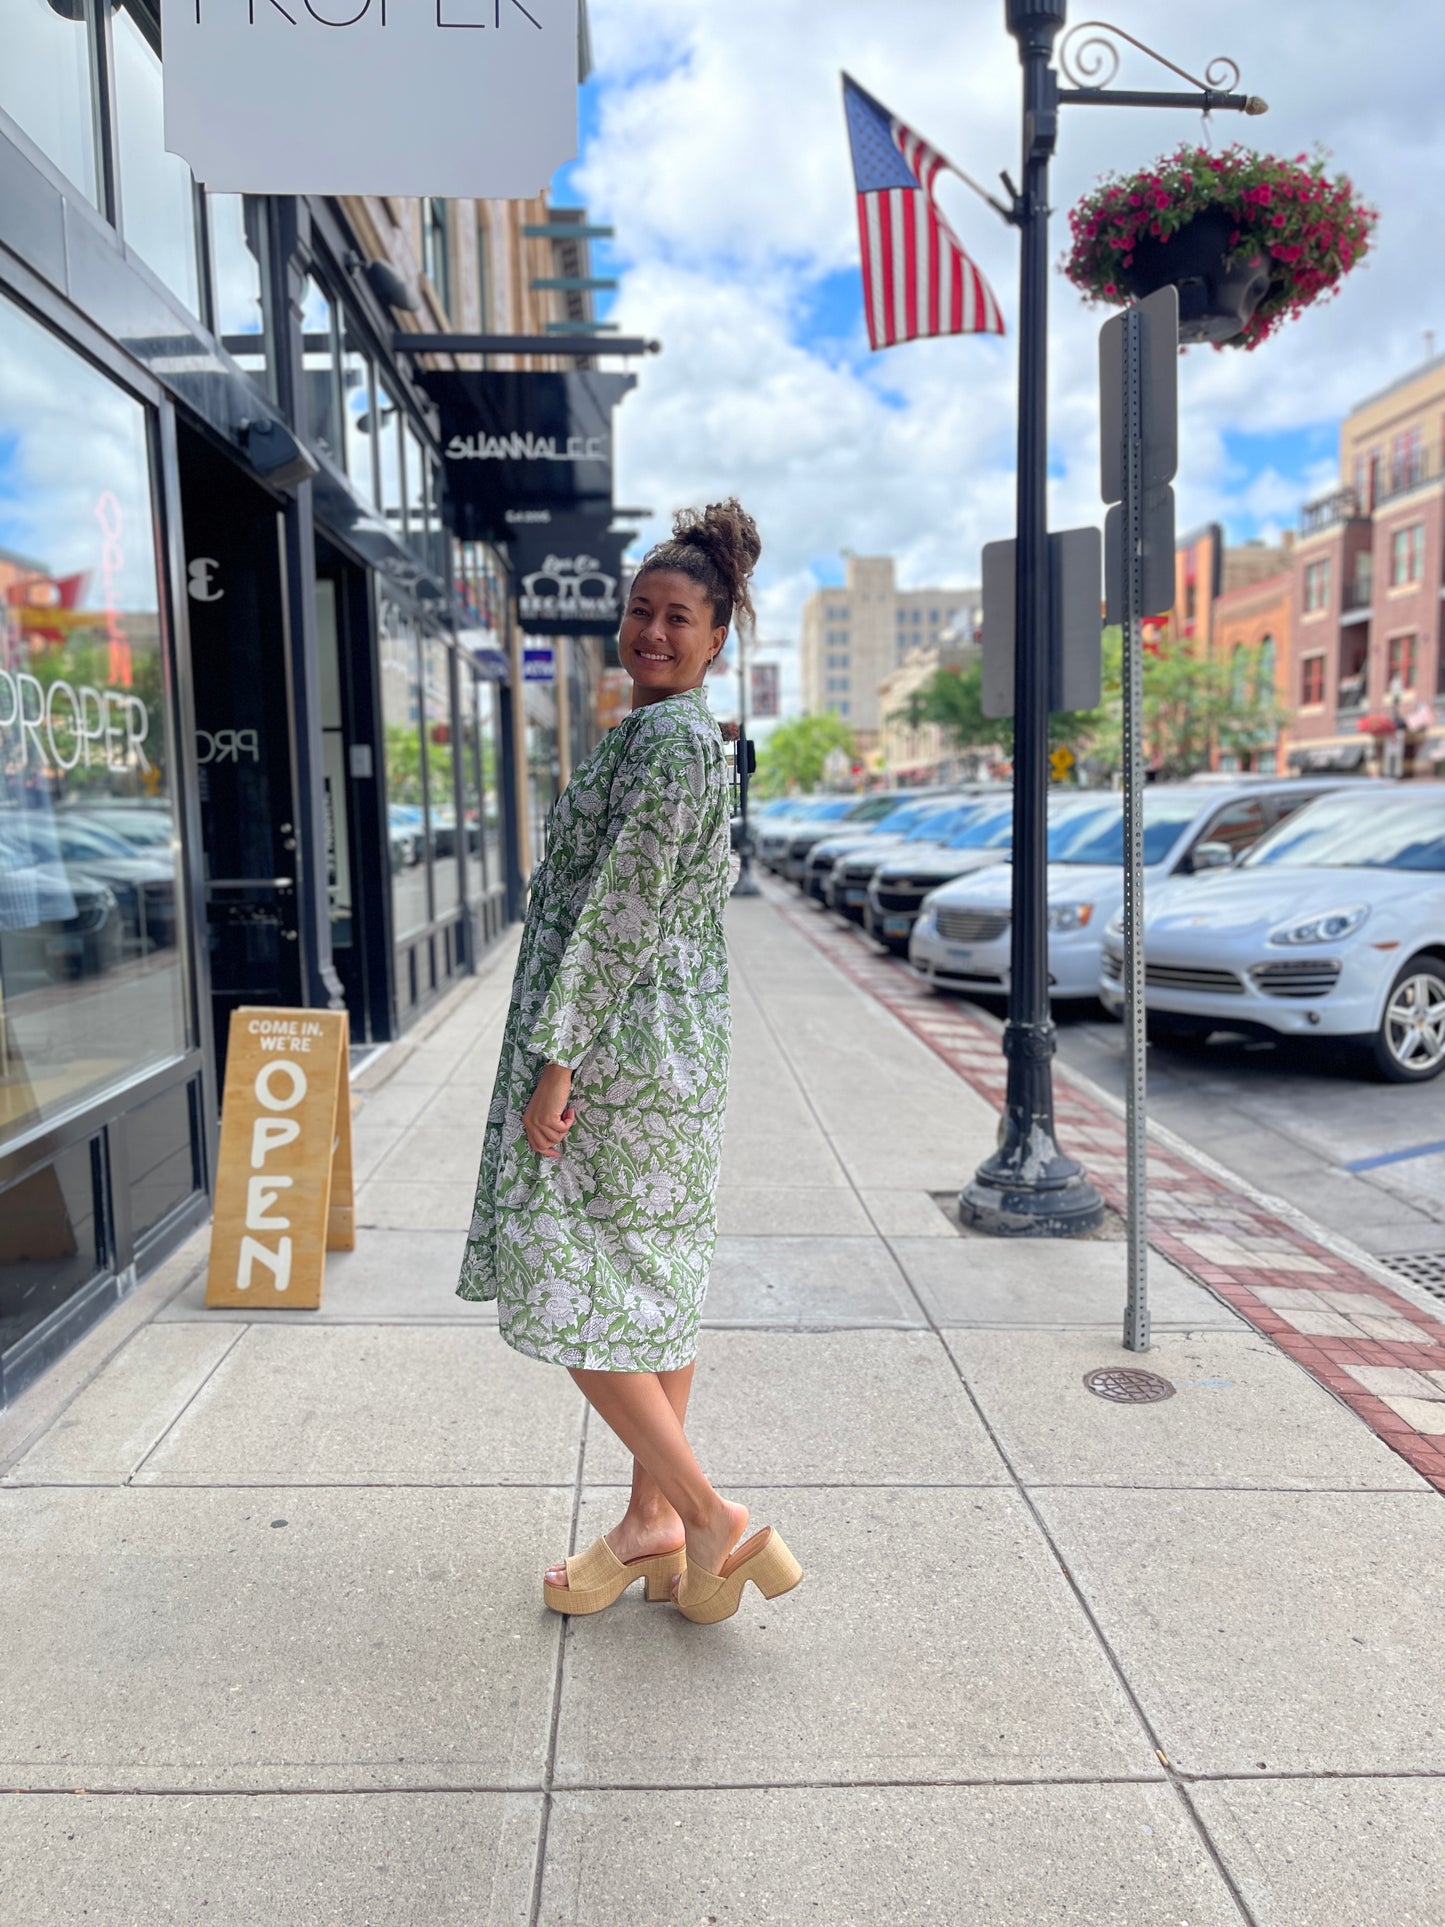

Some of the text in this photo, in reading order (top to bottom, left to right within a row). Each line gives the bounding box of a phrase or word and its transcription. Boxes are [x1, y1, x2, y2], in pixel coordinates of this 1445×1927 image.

[248, 1019, 298, 1036] COME
[260, 1036, 311, 1052] WE'RE
[236, 1059, 308, 1292] OPEN
